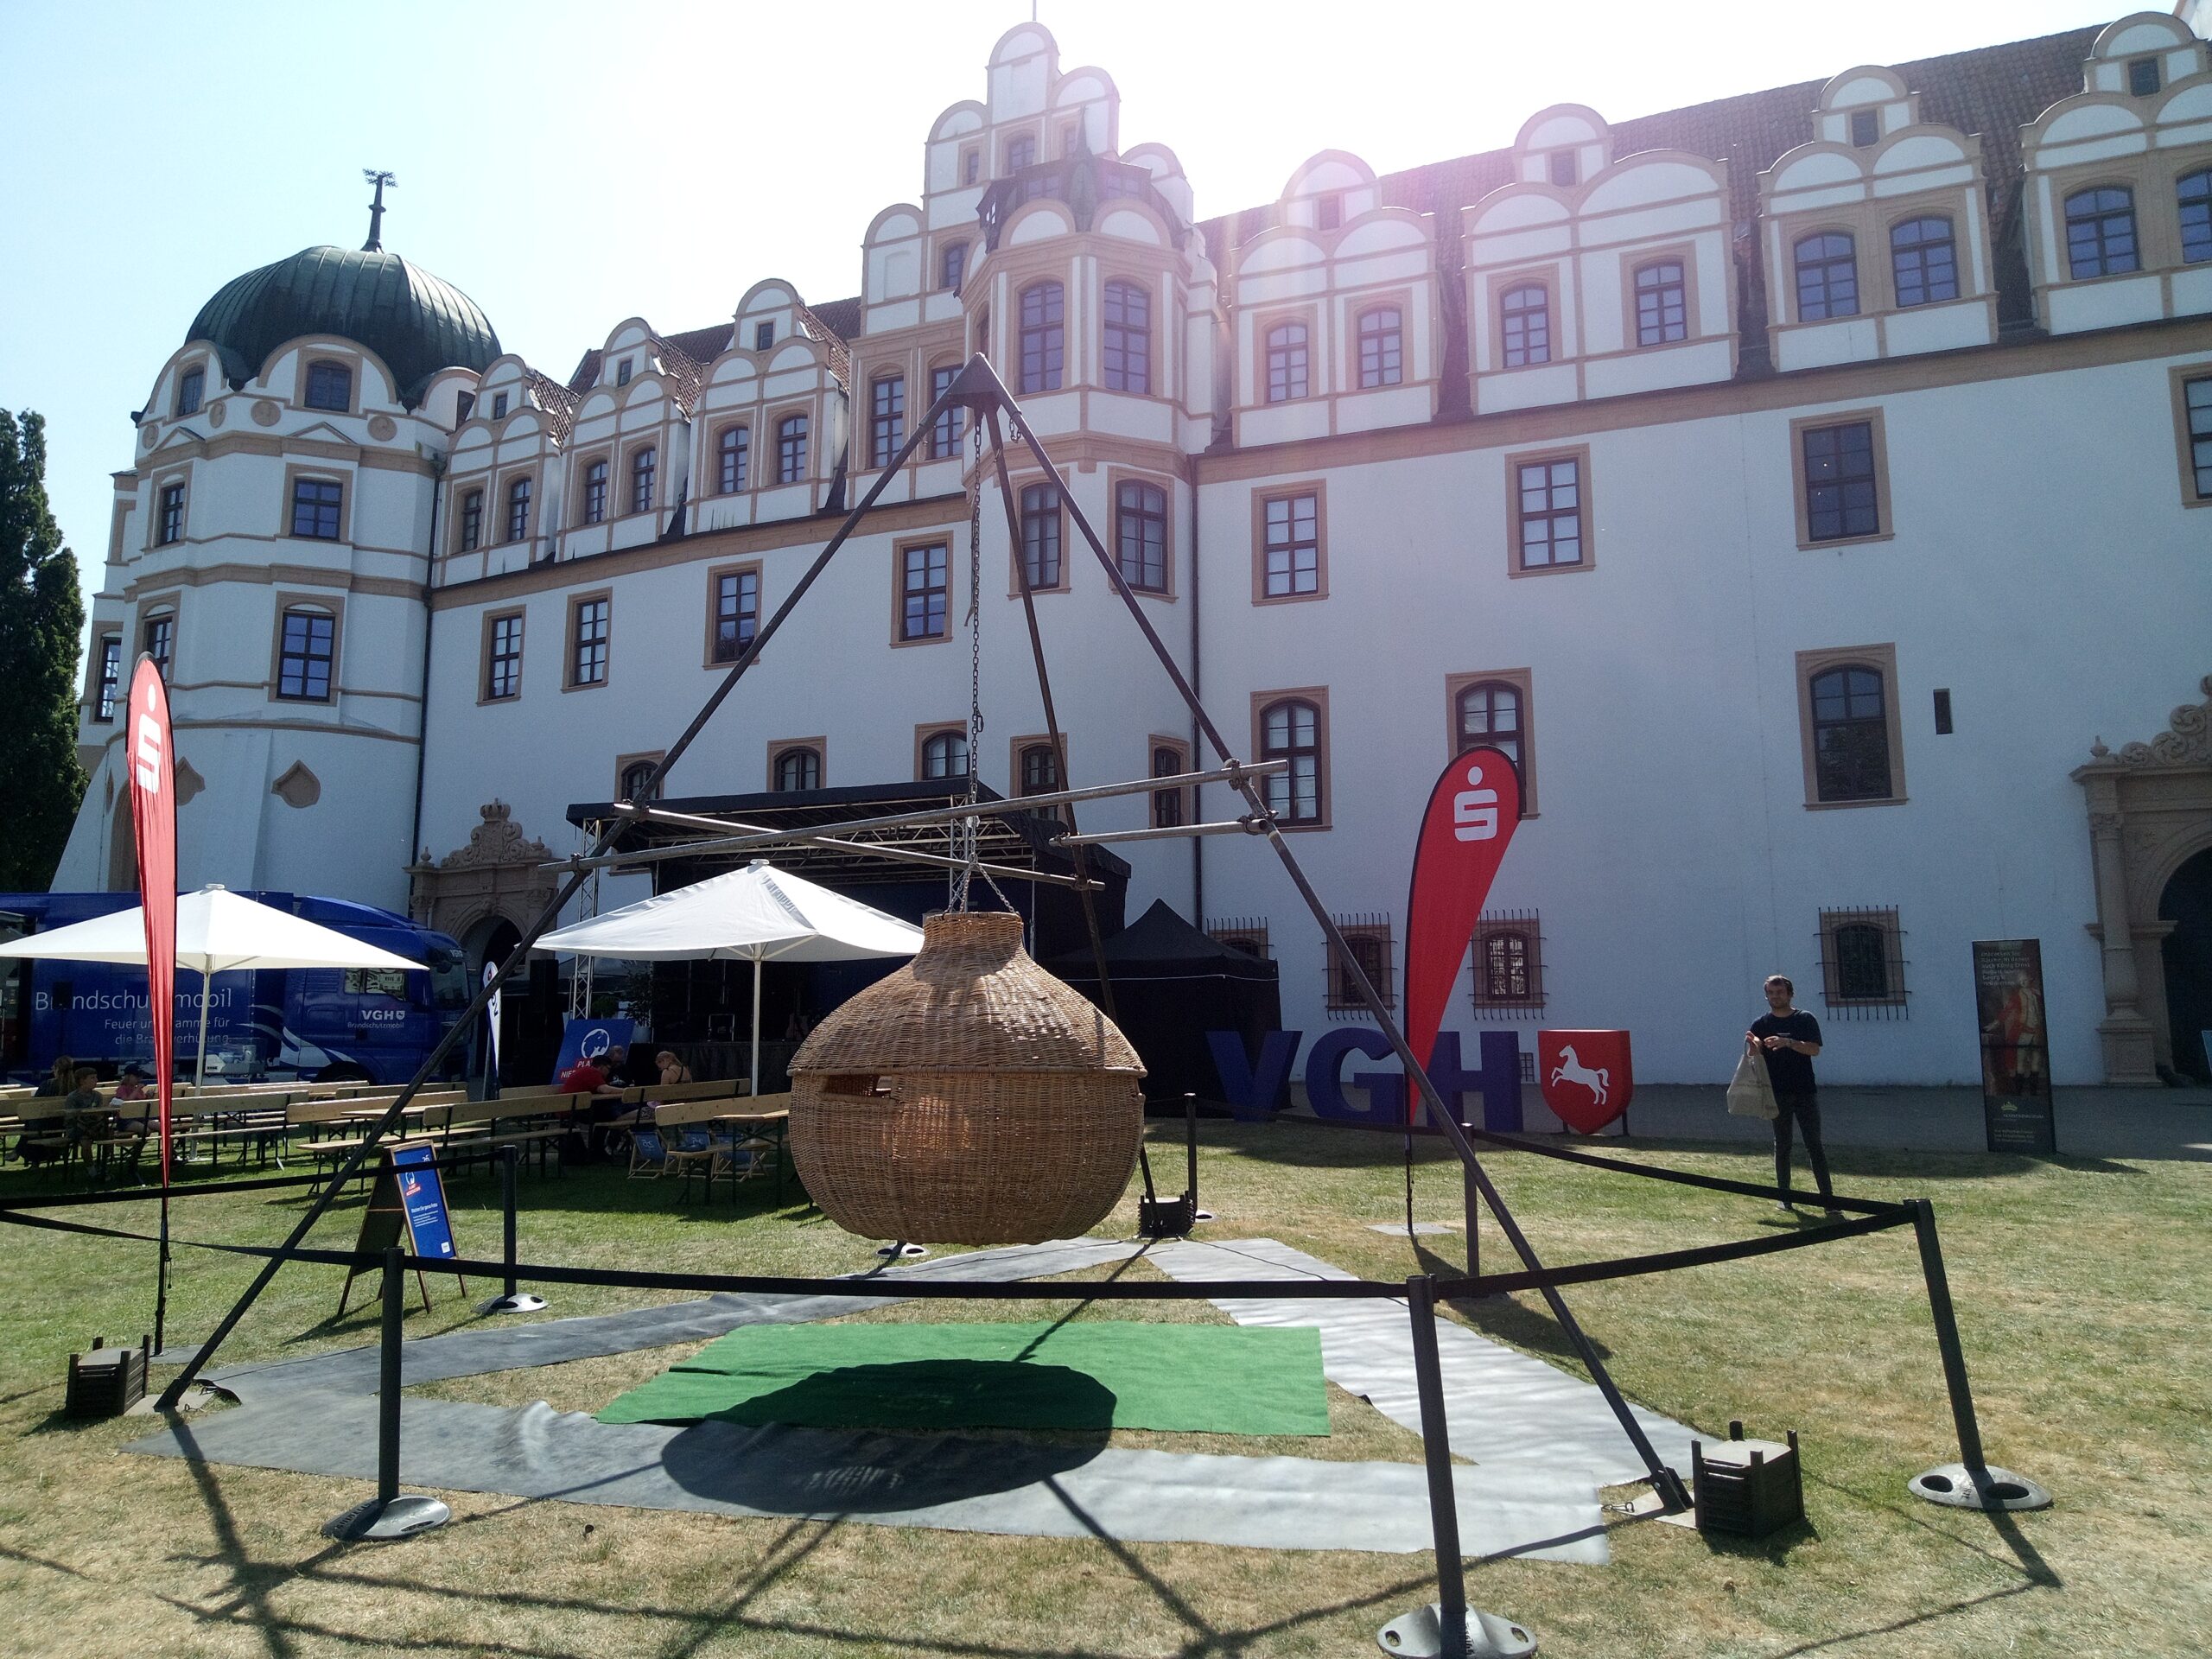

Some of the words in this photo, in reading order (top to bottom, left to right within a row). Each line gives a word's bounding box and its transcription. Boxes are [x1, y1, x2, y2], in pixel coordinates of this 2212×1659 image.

[1453, 788, 1498, 842] S
[35, 988, 232, 1010] Bndschumobil
[105, 1019, 137, 1029] Feuer
[214, 1017, 230, 1028] für
[361, 1009, 394, 1020] VGH
[115, 1033, 133, 1045] die
[1205, 1027, 1523, 1133] VGH
